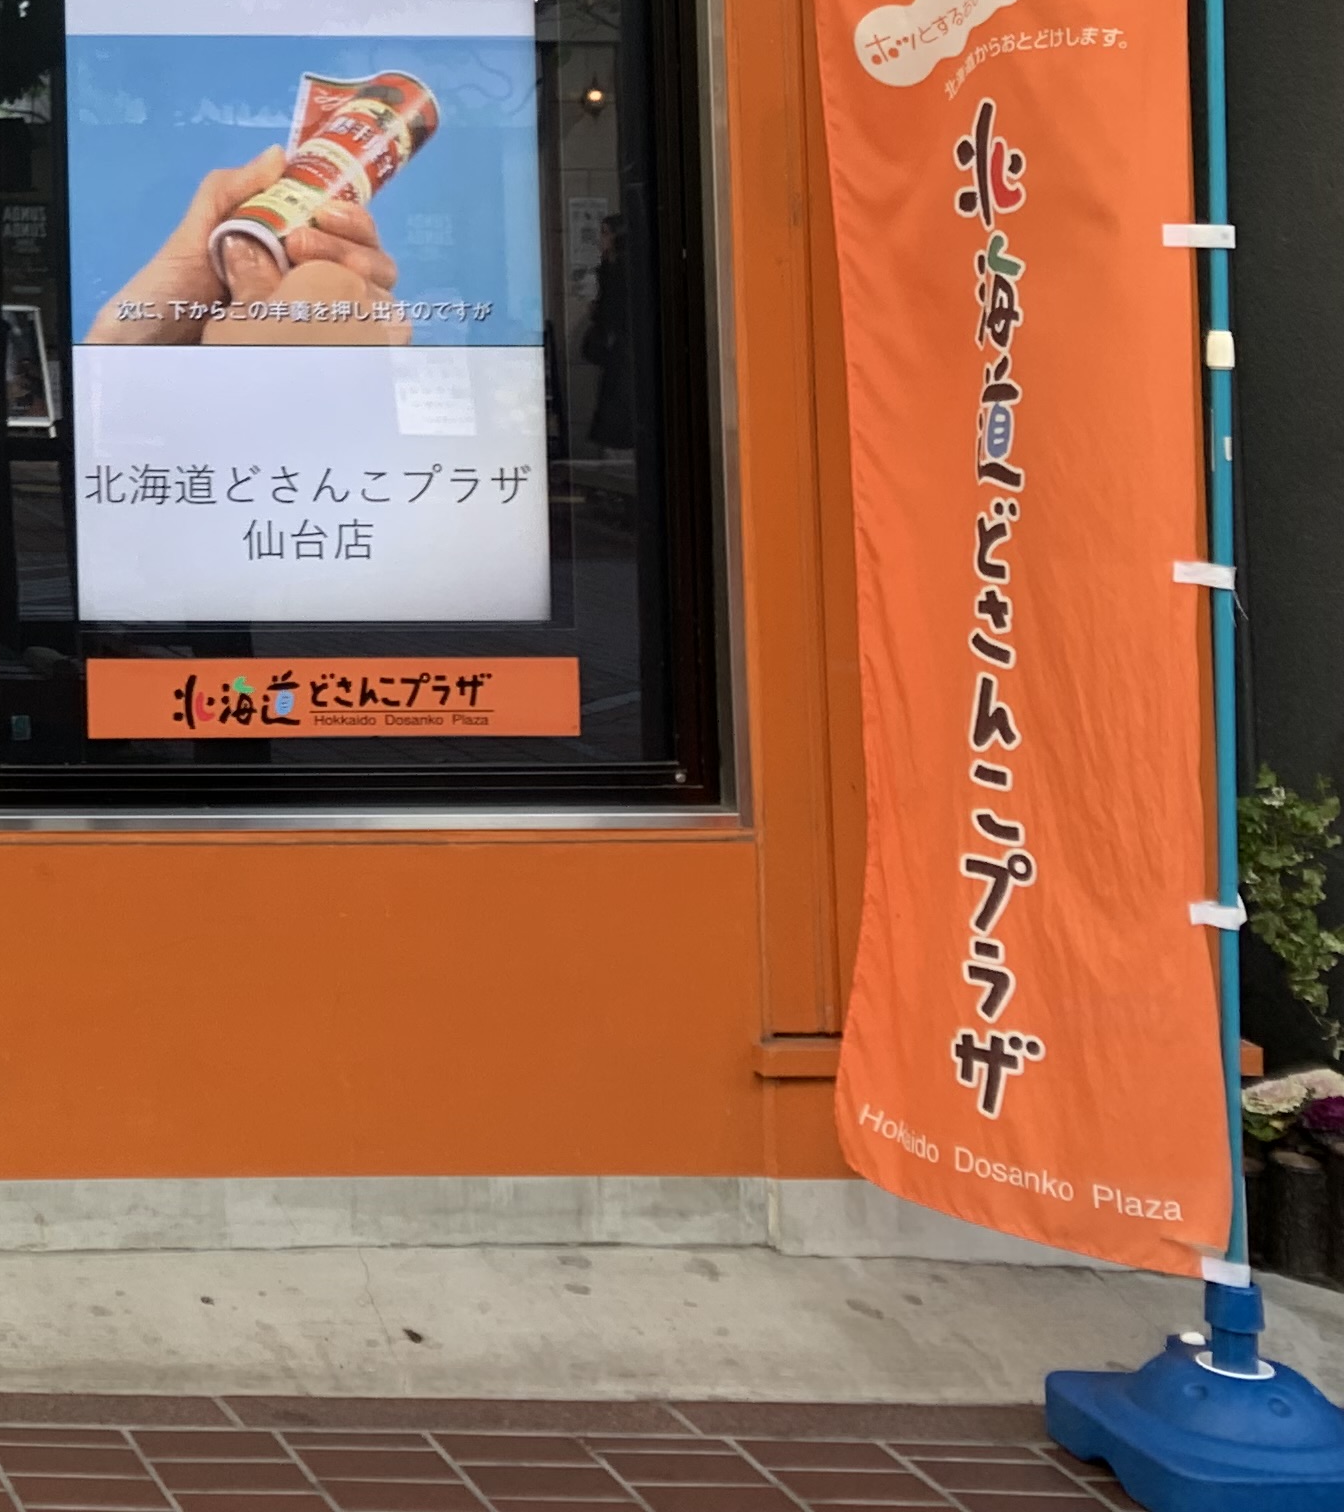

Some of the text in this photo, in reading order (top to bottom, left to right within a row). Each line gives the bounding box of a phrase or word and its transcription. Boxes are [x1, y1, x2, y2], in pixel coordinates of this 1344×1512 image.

[84, 463, 532, 506] 北海道どさんこプラザ
[242, 517, 375, 564] 仙台店
[173, 670, 493, 729] 北海道 どさんこプラザ
[314, 714, 489, 727] Hokkaido Dosanko Plaza
[954, 1146, 1075, 1202] Dosanko
[1092, 1183, 1184, 1222] Plaza
